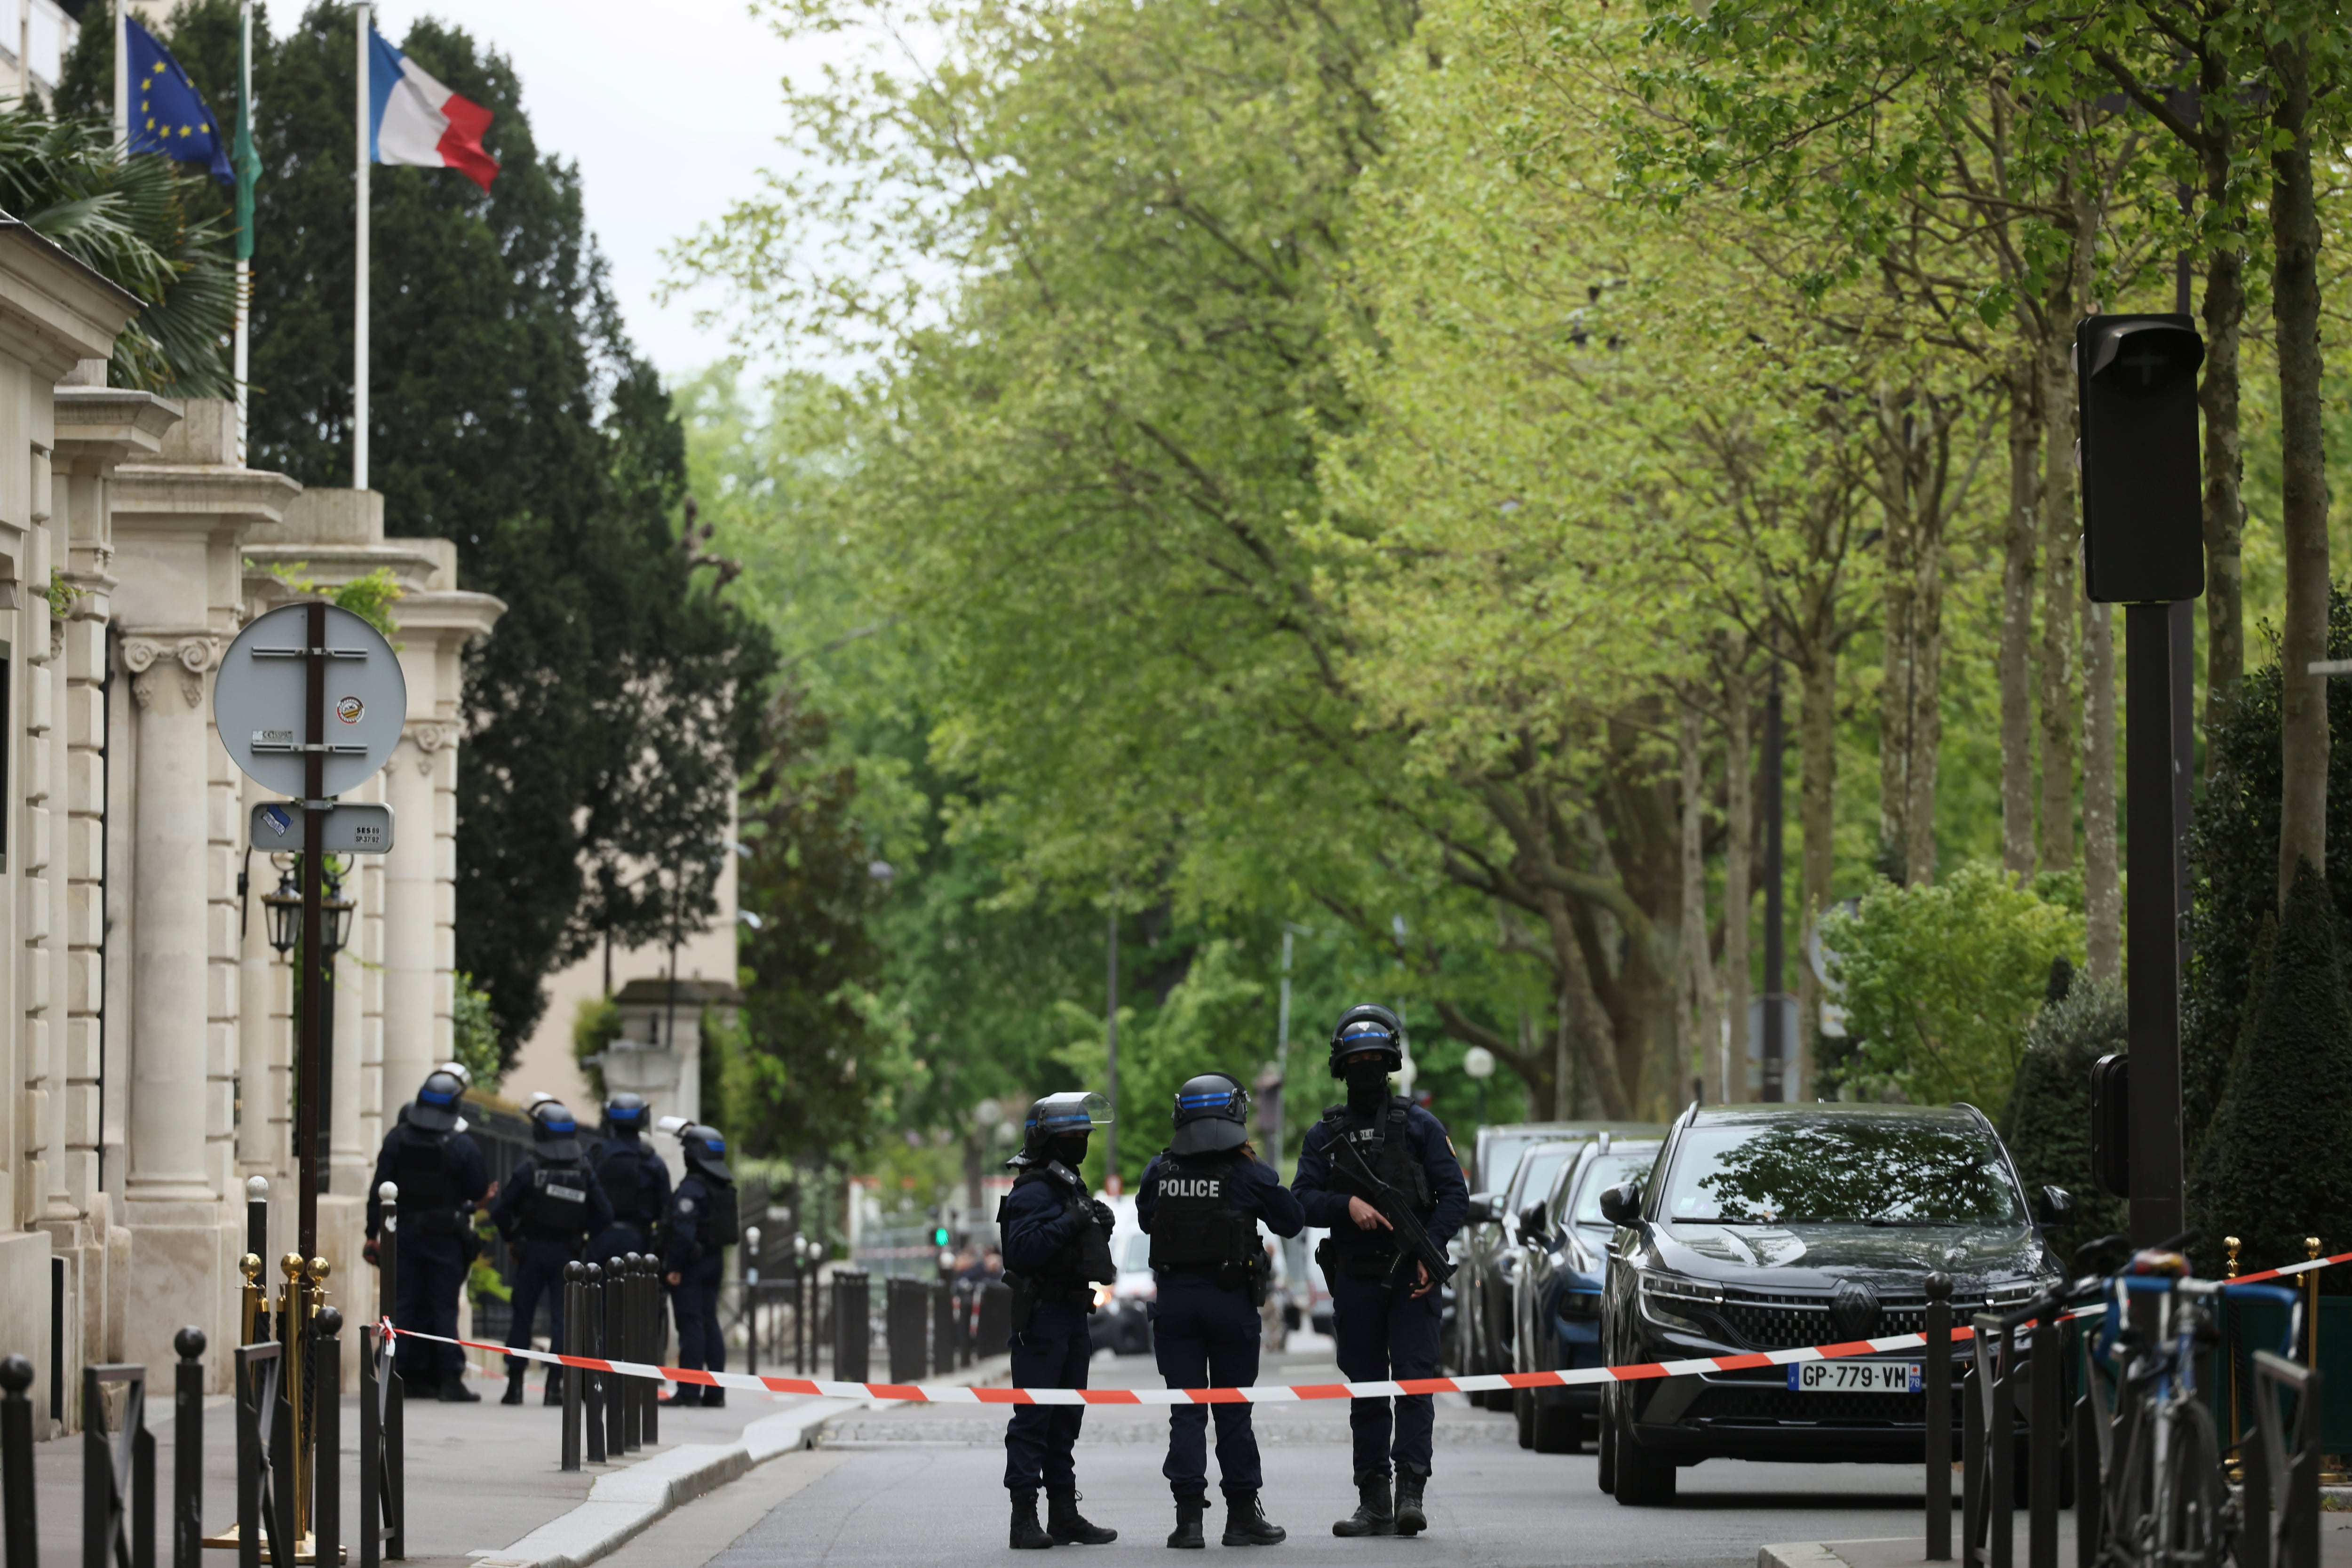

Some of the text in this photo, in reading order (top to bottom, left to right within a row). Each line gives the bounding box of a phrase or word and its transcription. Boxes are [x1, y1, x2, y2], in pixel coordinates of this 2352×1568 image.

[1159, 1179, 1219, 1197] POLICE
[1803, 1366, 1906, 1387] GP-779-VM
[1910, 1377, 1920, 1387] 78
